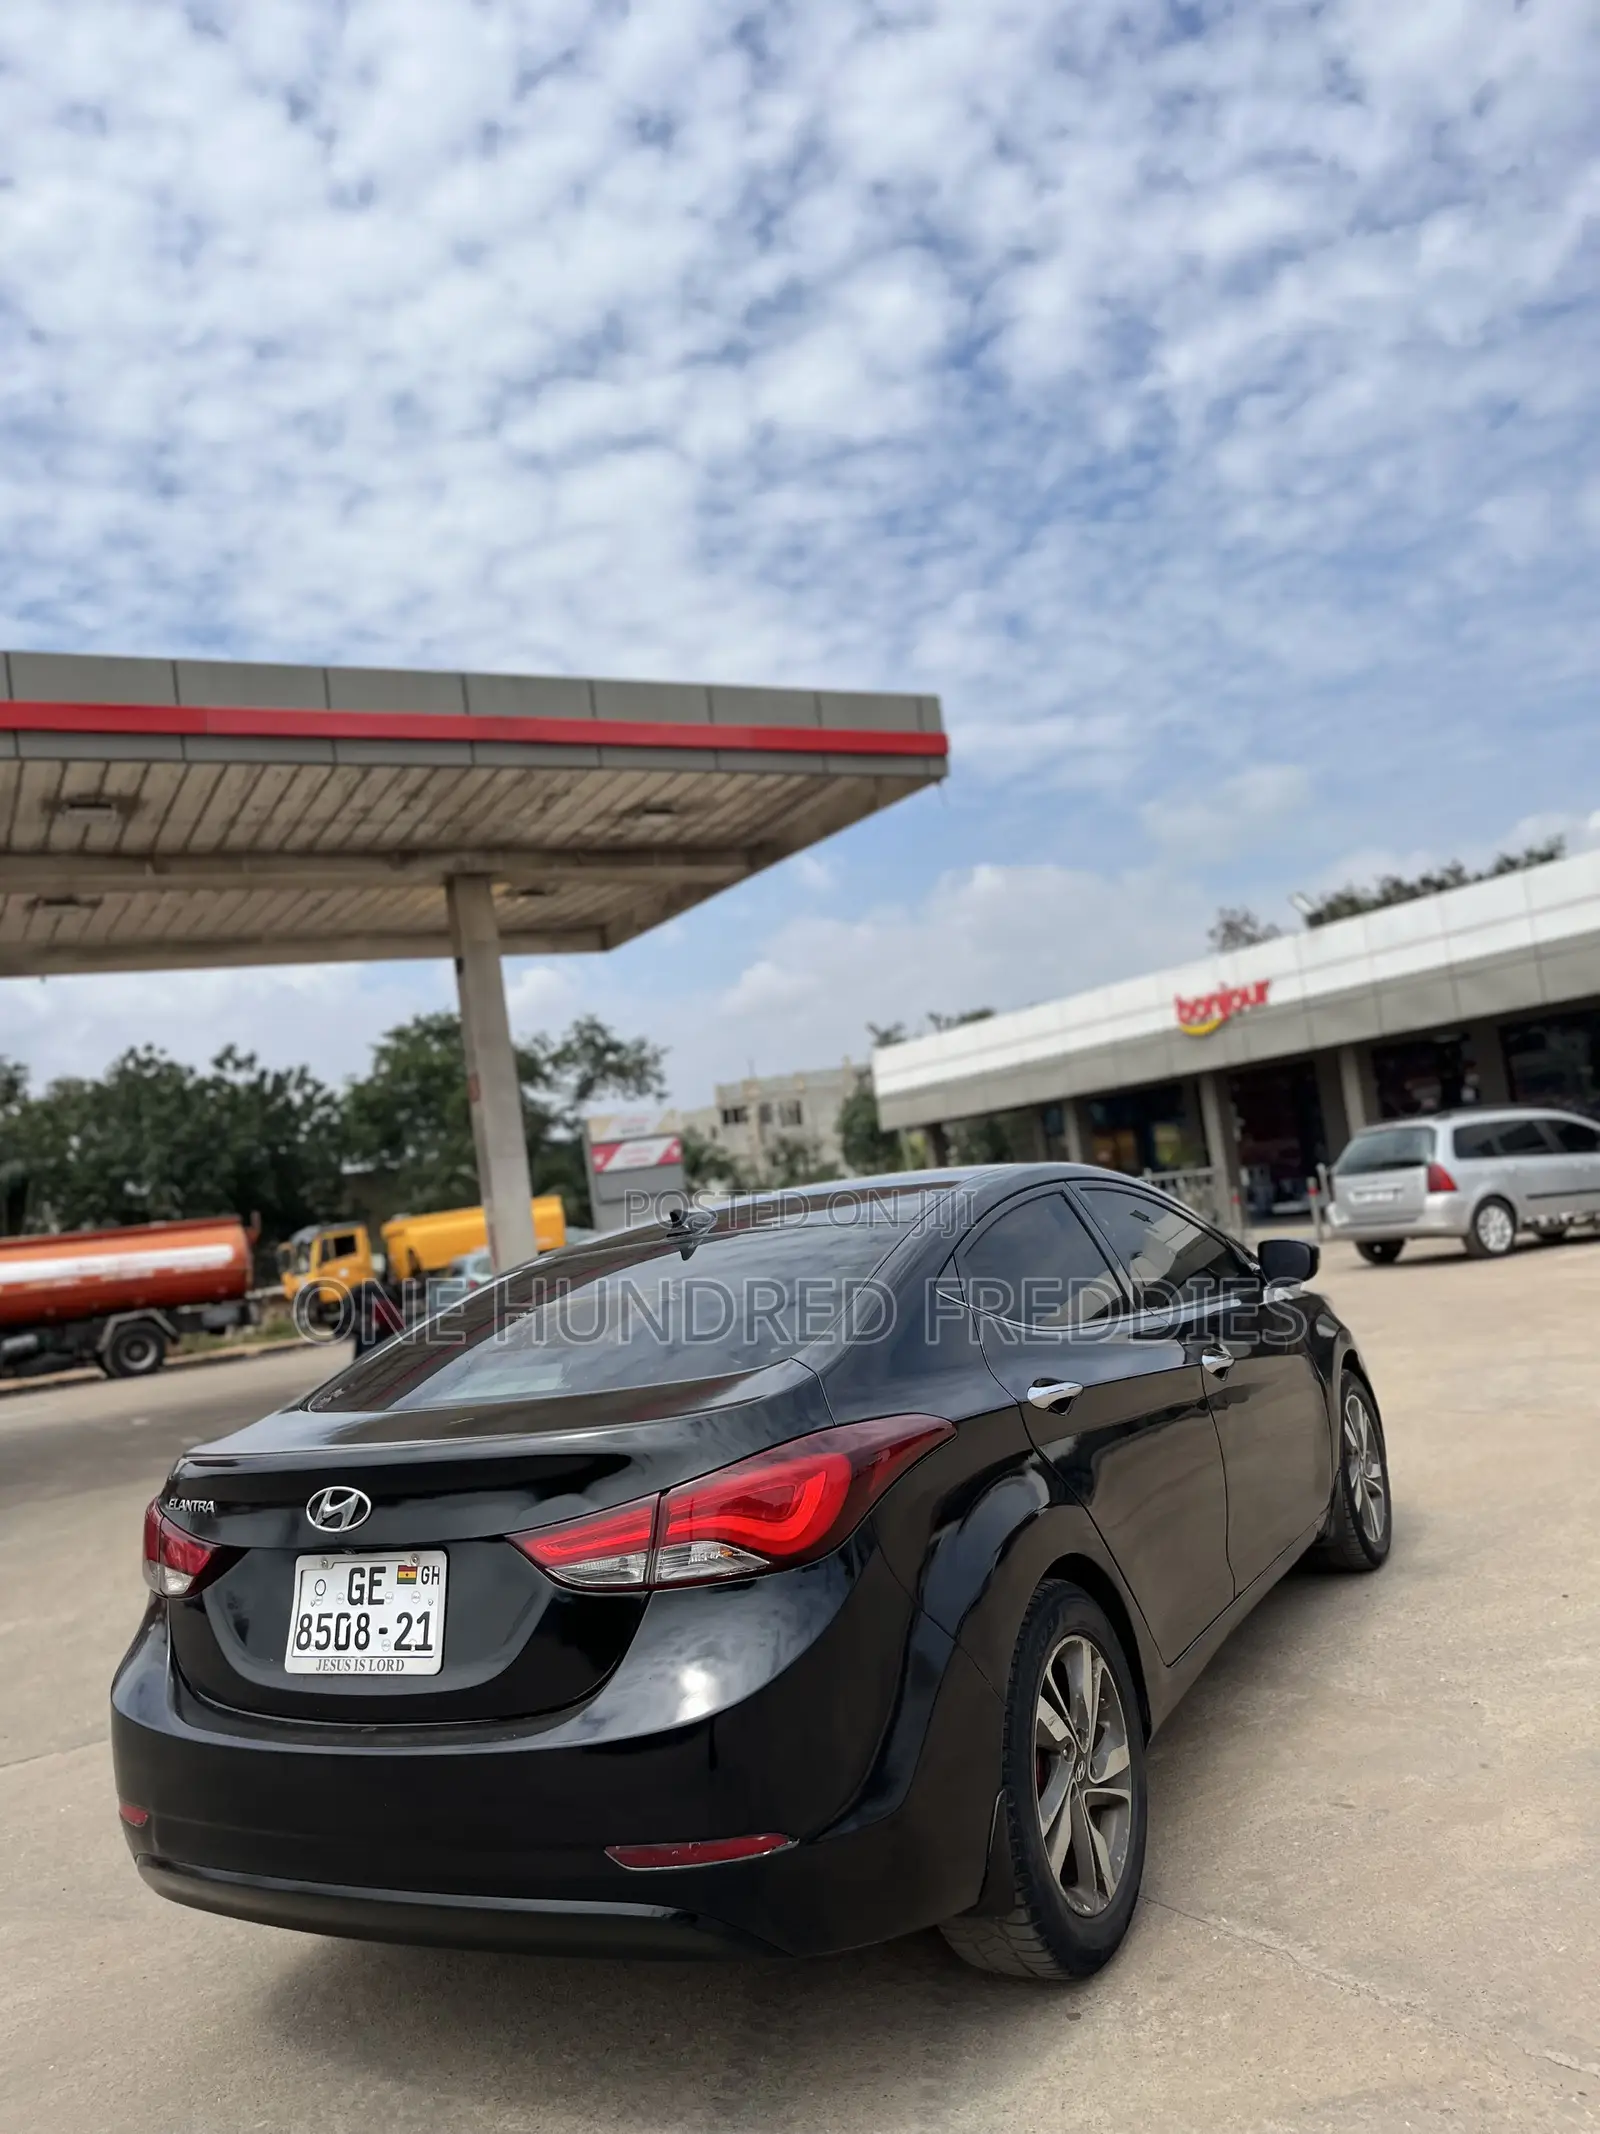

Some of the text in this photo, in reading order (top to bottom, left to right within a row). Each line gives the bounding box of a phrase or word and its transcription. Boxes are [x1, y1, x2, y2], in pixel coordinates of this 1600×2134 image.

[168, 1498, 215, 1513] ELANTRA
[421, 1566, 440, 1585] GH
[347, 1566, 386, 1605] GE
[316, 1658, 405, 1672] JESUS IS LORD
